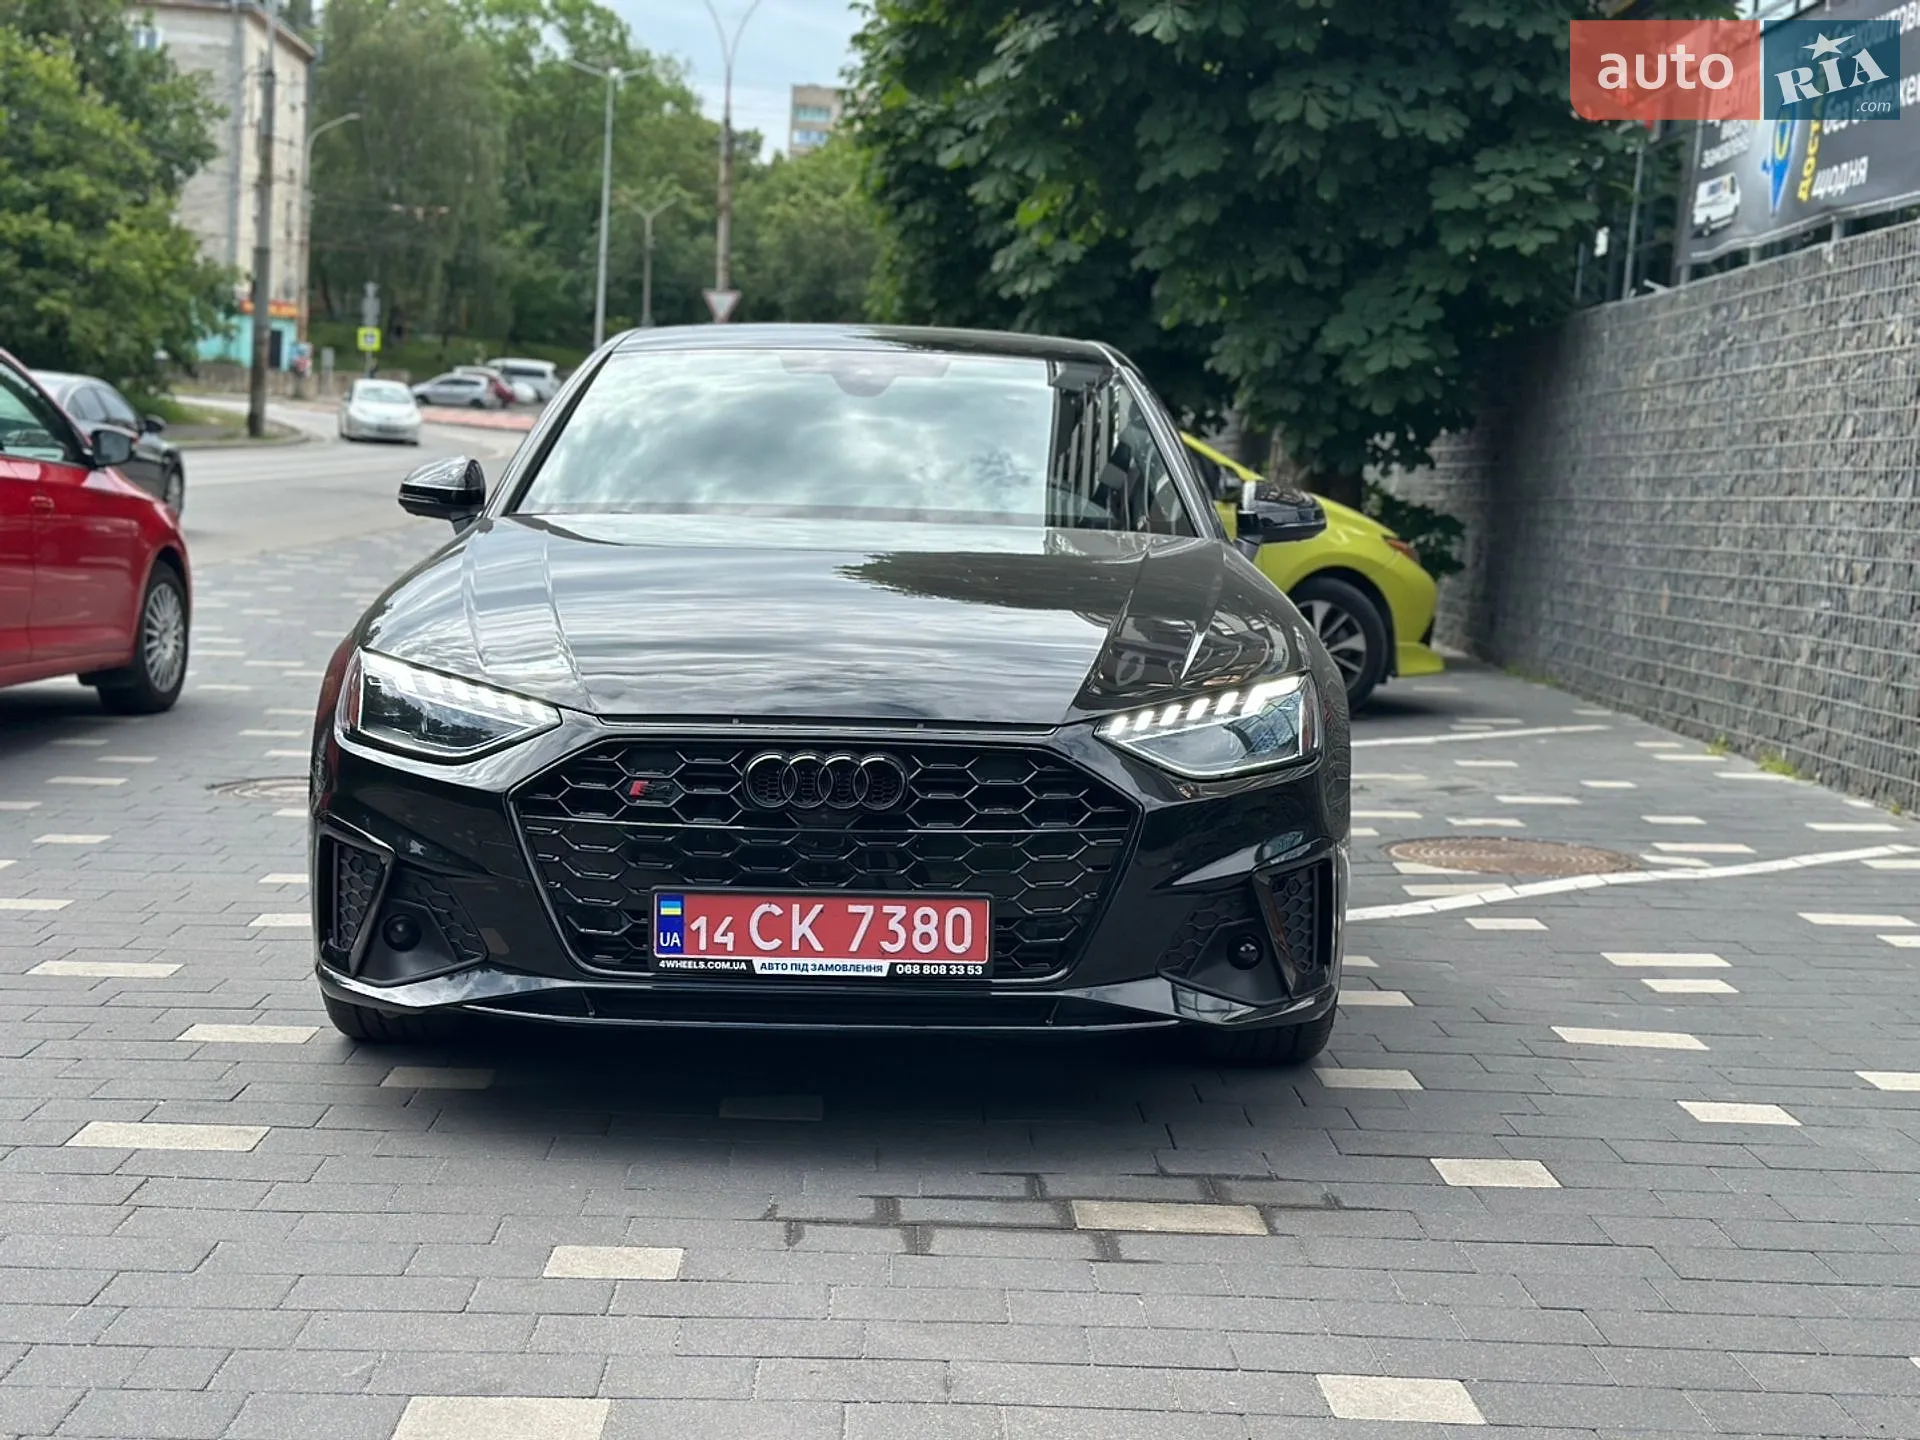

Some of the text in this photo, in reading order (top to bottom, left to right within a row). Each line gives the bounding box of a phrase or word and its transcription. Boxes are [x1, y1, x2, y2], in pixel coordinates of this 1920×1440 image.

[690, 903, 973, 954] 14 CK 7380
[659, 931, 681, 947] UA
[659, 959, 747, 970] 4WHEELS.COM.UA
[760, 962, 883, 974] АВТО ПІД ЗАМОВЛЕННЯ
[896, 964, 983, 975] 068 808 33 53
